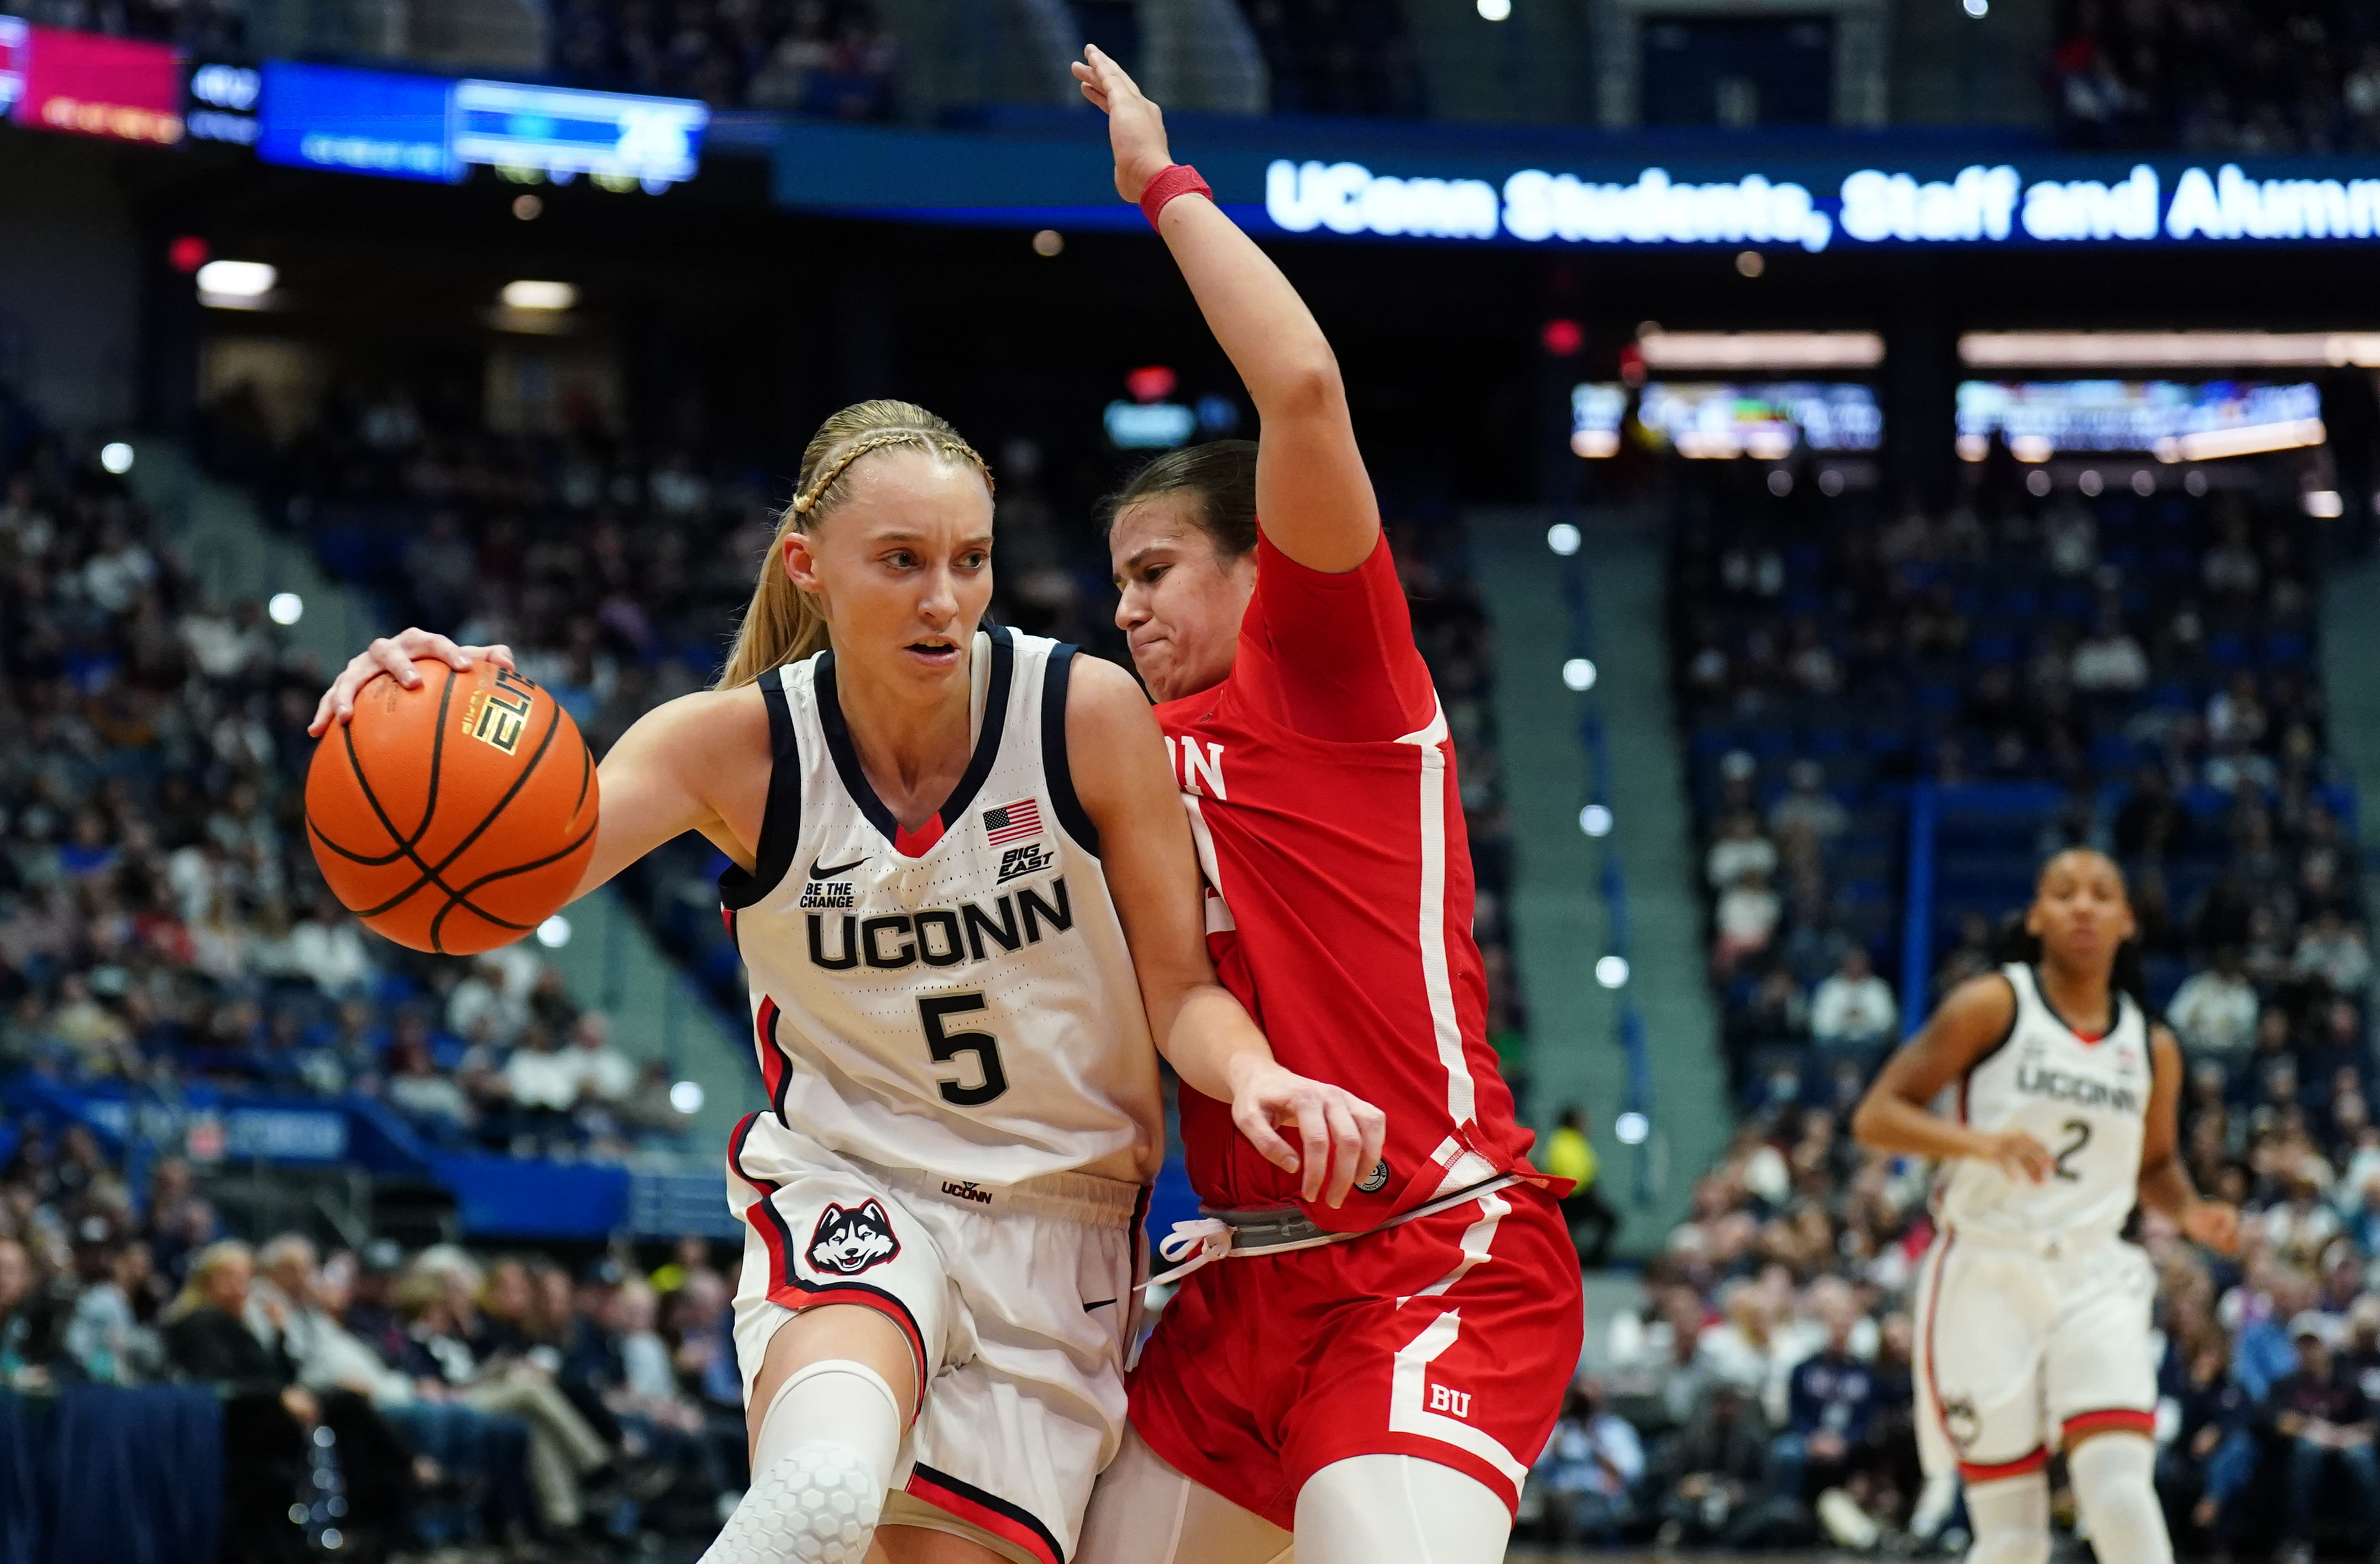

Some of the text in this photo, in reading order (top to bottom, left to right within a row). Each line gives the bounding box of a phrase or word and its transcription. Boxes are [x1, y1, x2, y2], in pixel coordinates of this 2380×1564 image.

[1266, 159, 1498, 239] UConn
[1503, 166, 1832, 253] Students,
[1841, 165, 2021, 242] Staff
[2022, 164, 2159, 241] and
[998, 851, 1055, 878] EAST
[1002, 843, 1041, 865] BIG
[799, 896, 854, 908] CHANGE
[805, 882, 852, 896] BE THE
[805, 873, 1075, 971] UCONN
[915, 990, 1009, 1108] 5
[2017, 1065, 2136, 1110] UCONN
[2054, 1120, 2090, 1181] 2
[941, 1181, 992, 1204] UCONN
[1430, 1383, 1471, 1418] BU
